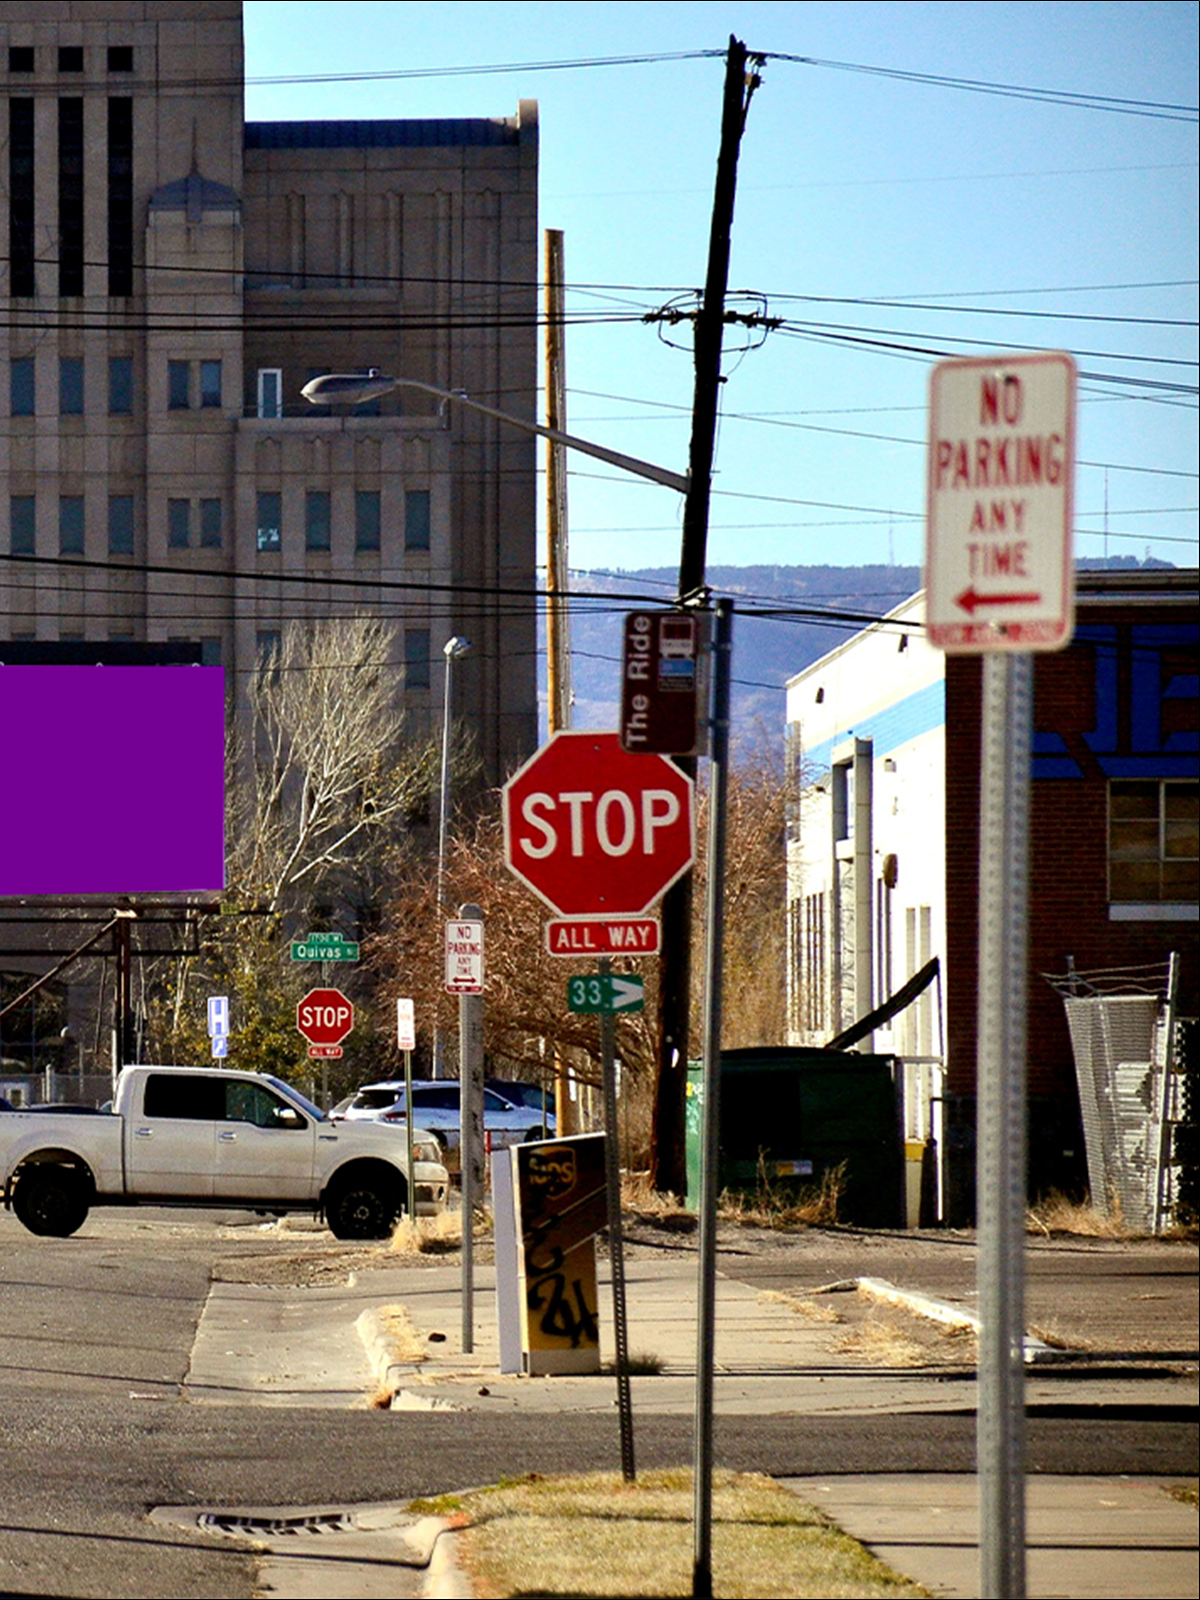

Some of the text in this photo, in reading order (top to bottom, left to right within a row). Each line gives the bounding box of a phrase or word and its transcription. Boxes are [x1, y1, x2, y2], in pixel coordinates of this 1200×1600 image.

[980, 374, 1023, 427] NO
[936, 433, 1062, 489] PARKING
[969, 499, 1026, 532] ANY
[966, 541, 1029, 578] TIME
[625, 615, 650, 747] The Ride
[519, 788, 680, 859] STOP
[457, 926, 472, 939] NO
[556, 925, 650, 948] ALL WAY
[297, 945, 341, 958] Quivas
[448, 942, 481, 955] PARKING
[458, 957, 471, 965] ANY
[572, 980, 601, 1005] 33
[211, 1000, 226, 1035] H
[301, 1006, 349, 1027] STOP
[325, 1047, 339, 1055] WAY
